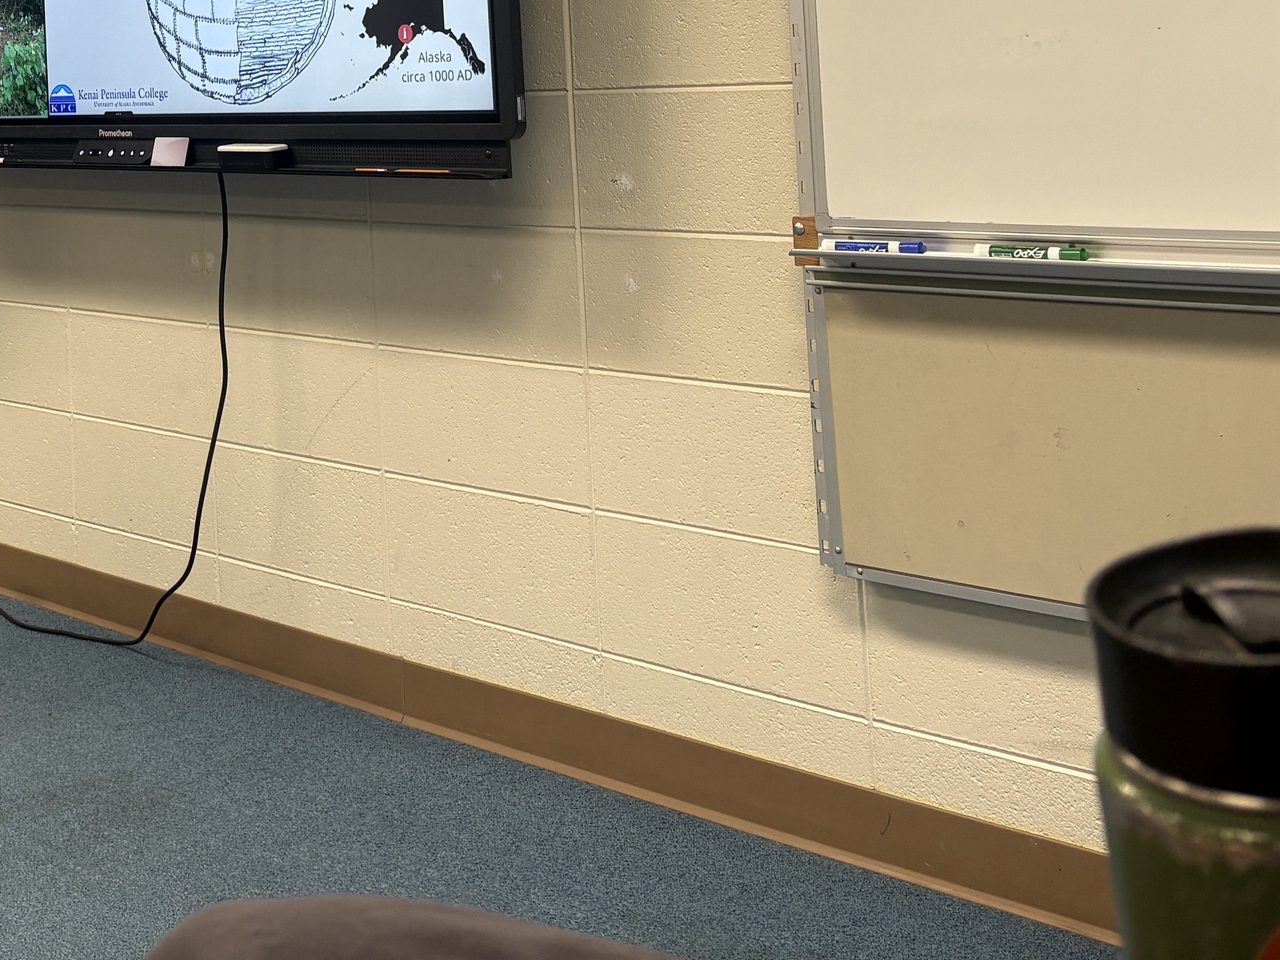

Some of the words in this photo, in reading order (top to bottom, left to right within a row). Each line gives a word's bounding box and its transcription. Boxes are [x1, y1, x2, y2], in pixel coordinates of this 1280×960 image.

[418, 50, 452, 63] Alaska
[401, 71, 426, 83] circa
[429, 70, 455, 82] 1000
[457, 69, 473, 81] AD
[78, 88, 98, 100] Kenai
[101, 87, 136, 100] Peninsula
[138, 87, 169, 101] College
[98, 129, 133, 137] Promethean
[1013, 247, 1045, 258] EXPO
